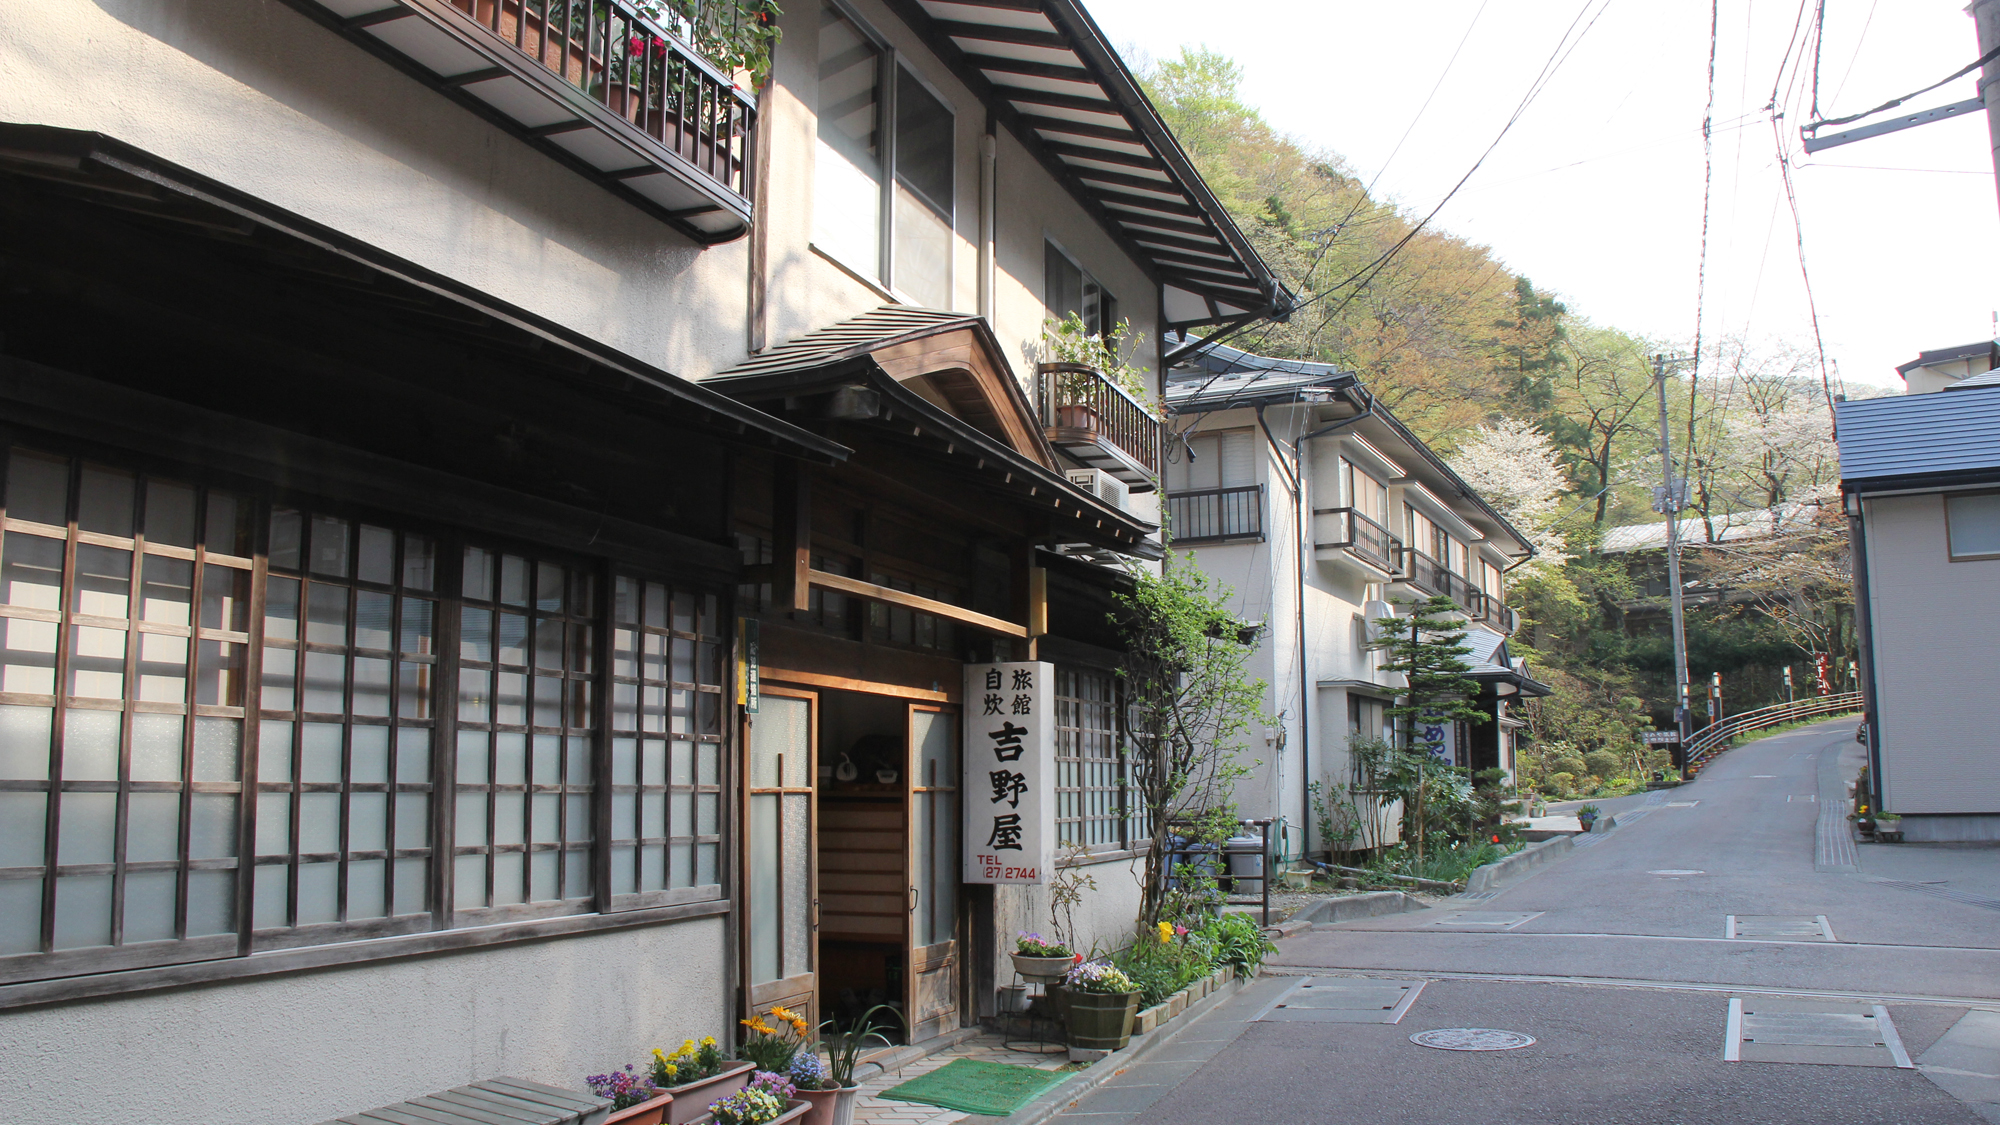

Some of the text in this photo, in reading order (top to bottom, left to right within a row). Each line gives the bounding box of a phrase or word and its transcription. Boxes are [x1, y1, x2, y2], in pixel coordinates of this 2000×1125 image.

[984, 668, 1005, 715] 自炊
[1011, 668, 1033, 716] 旅館
[987, 721, 1028, 851] 吉野屋
[977, 855, 1002, 865] TEL
